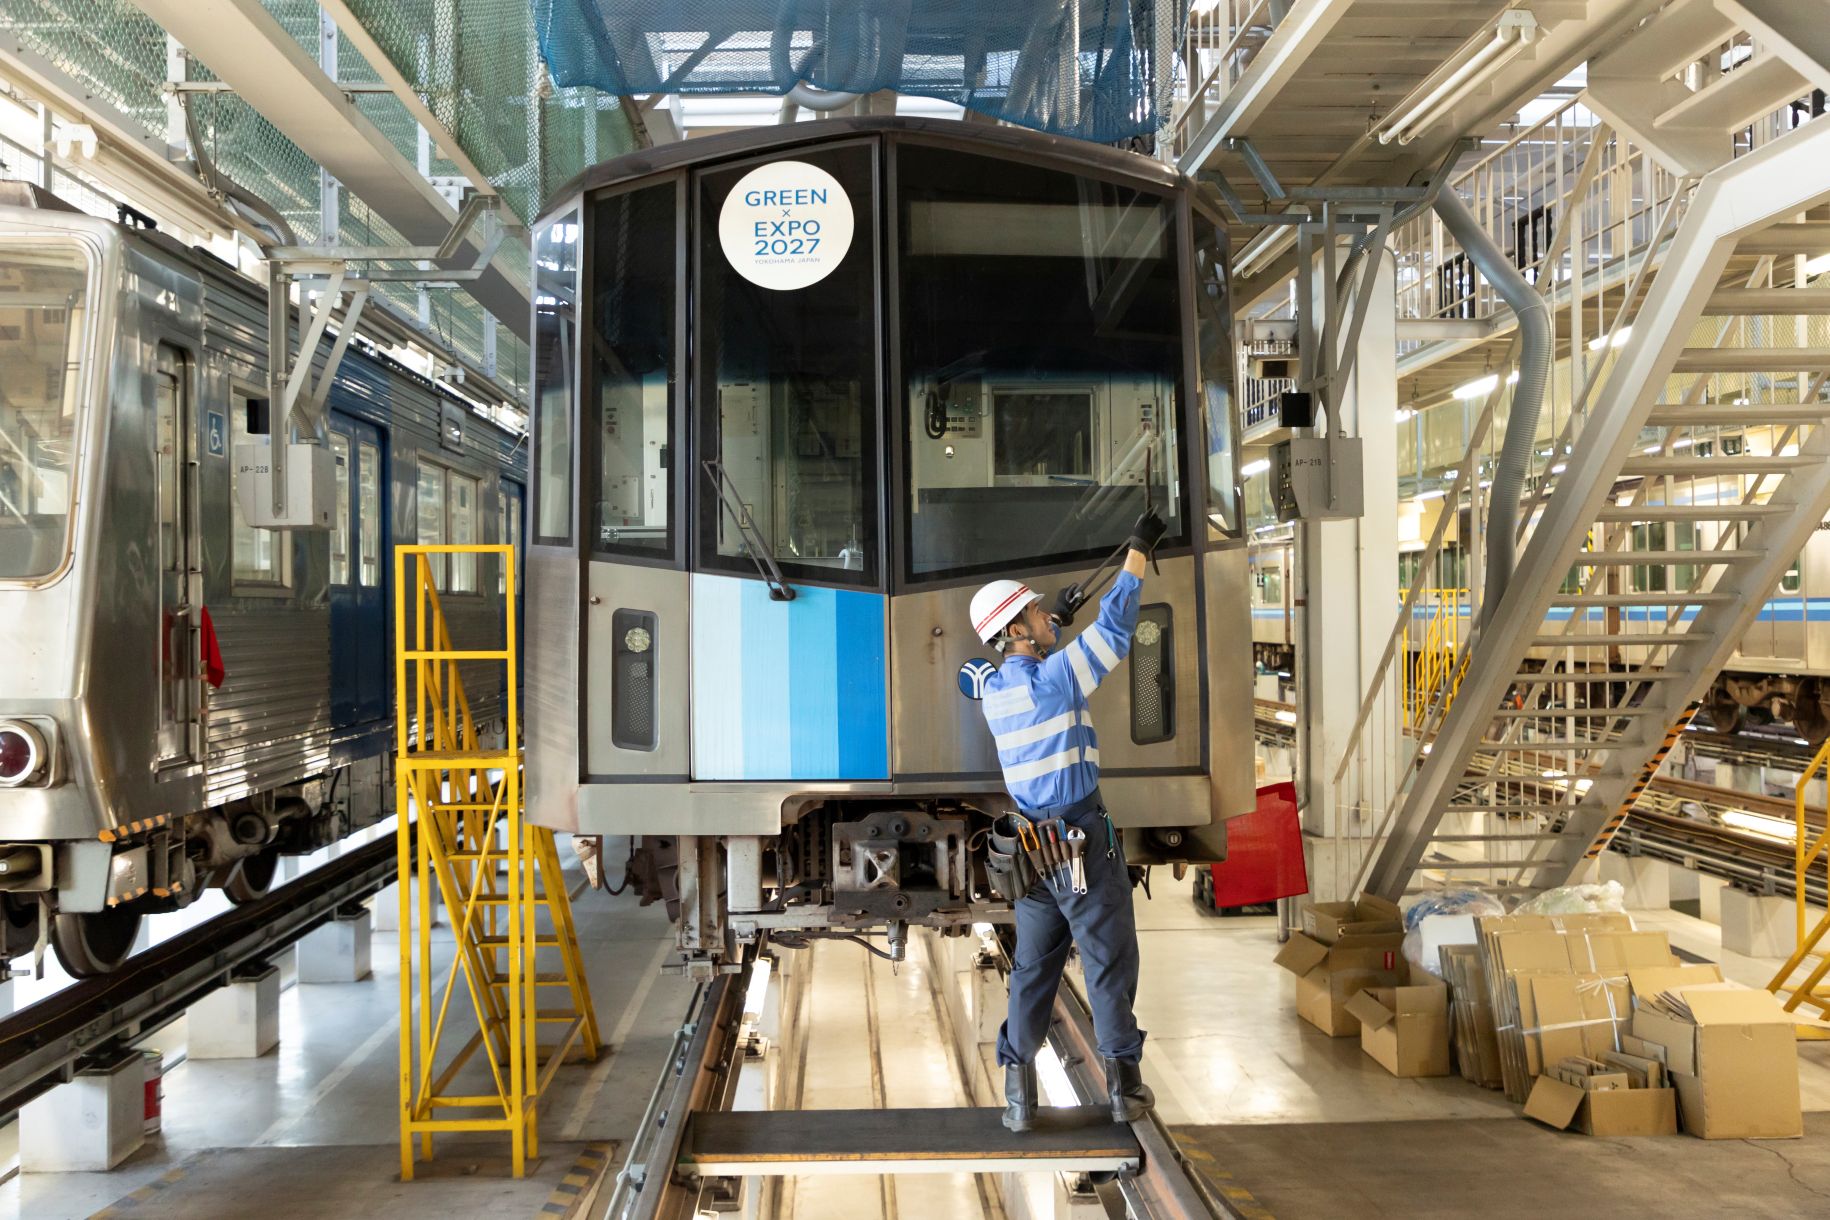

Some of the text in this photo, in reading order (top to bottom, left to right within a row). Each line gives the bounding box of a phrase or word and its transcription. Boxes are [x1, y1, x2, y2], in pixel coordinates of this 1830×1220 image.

[745, 188, 827, 207] GREEN
[754, 219, 821, 237] EXPO
[754, 238, 821, 256] 2027
